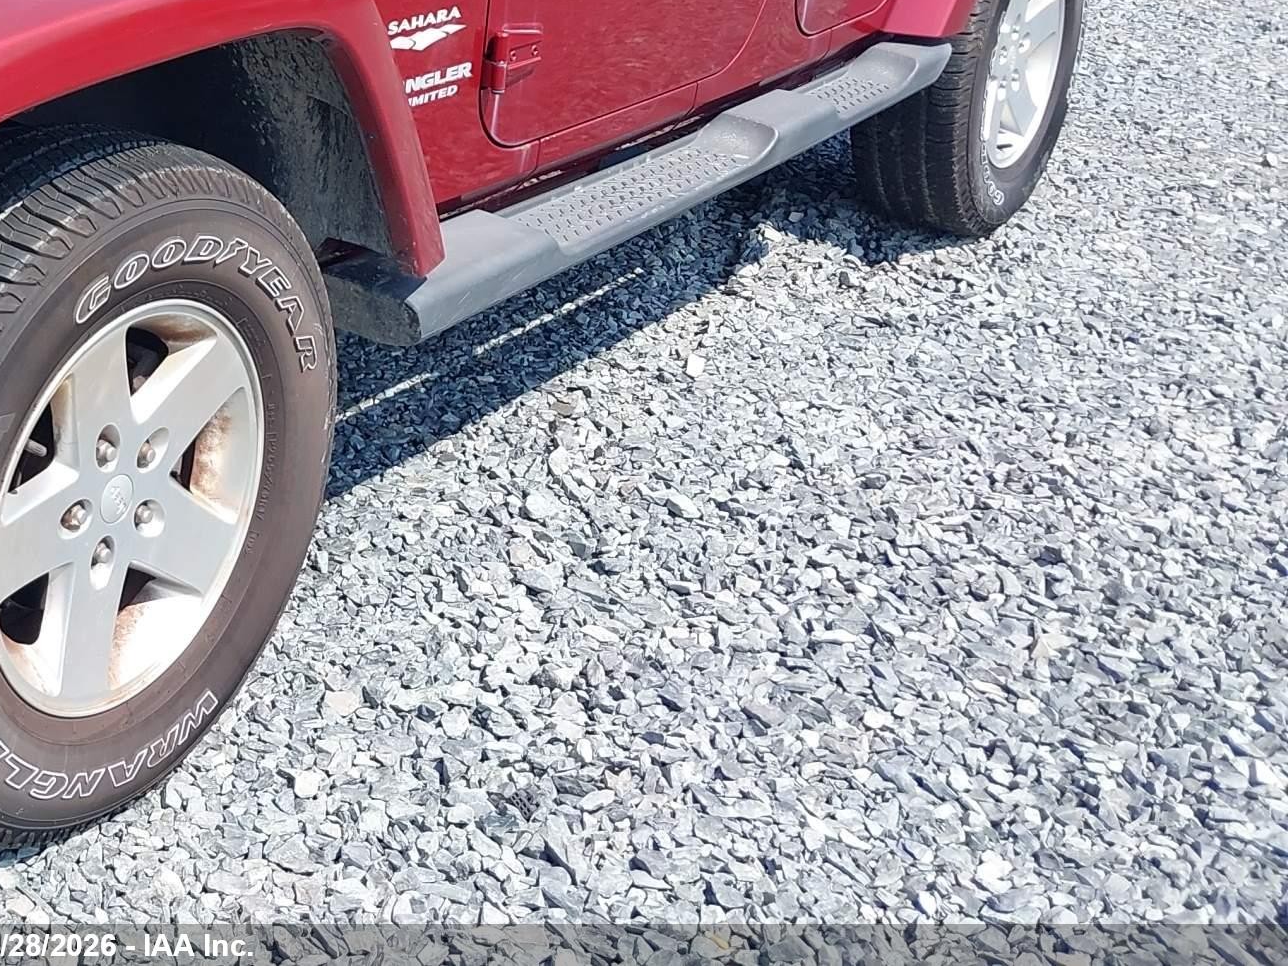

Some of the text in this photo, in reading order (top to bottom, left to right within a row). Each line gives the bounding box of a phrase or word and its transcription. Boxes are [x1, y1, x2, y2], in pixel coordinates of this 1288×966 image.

[388, 6, 461, 35] SAHARA
[403, 62, 473, 93] NGLER
[408, 85, 458, 106] IMITED
[75, 235, 319, 372] GOODYEAR
